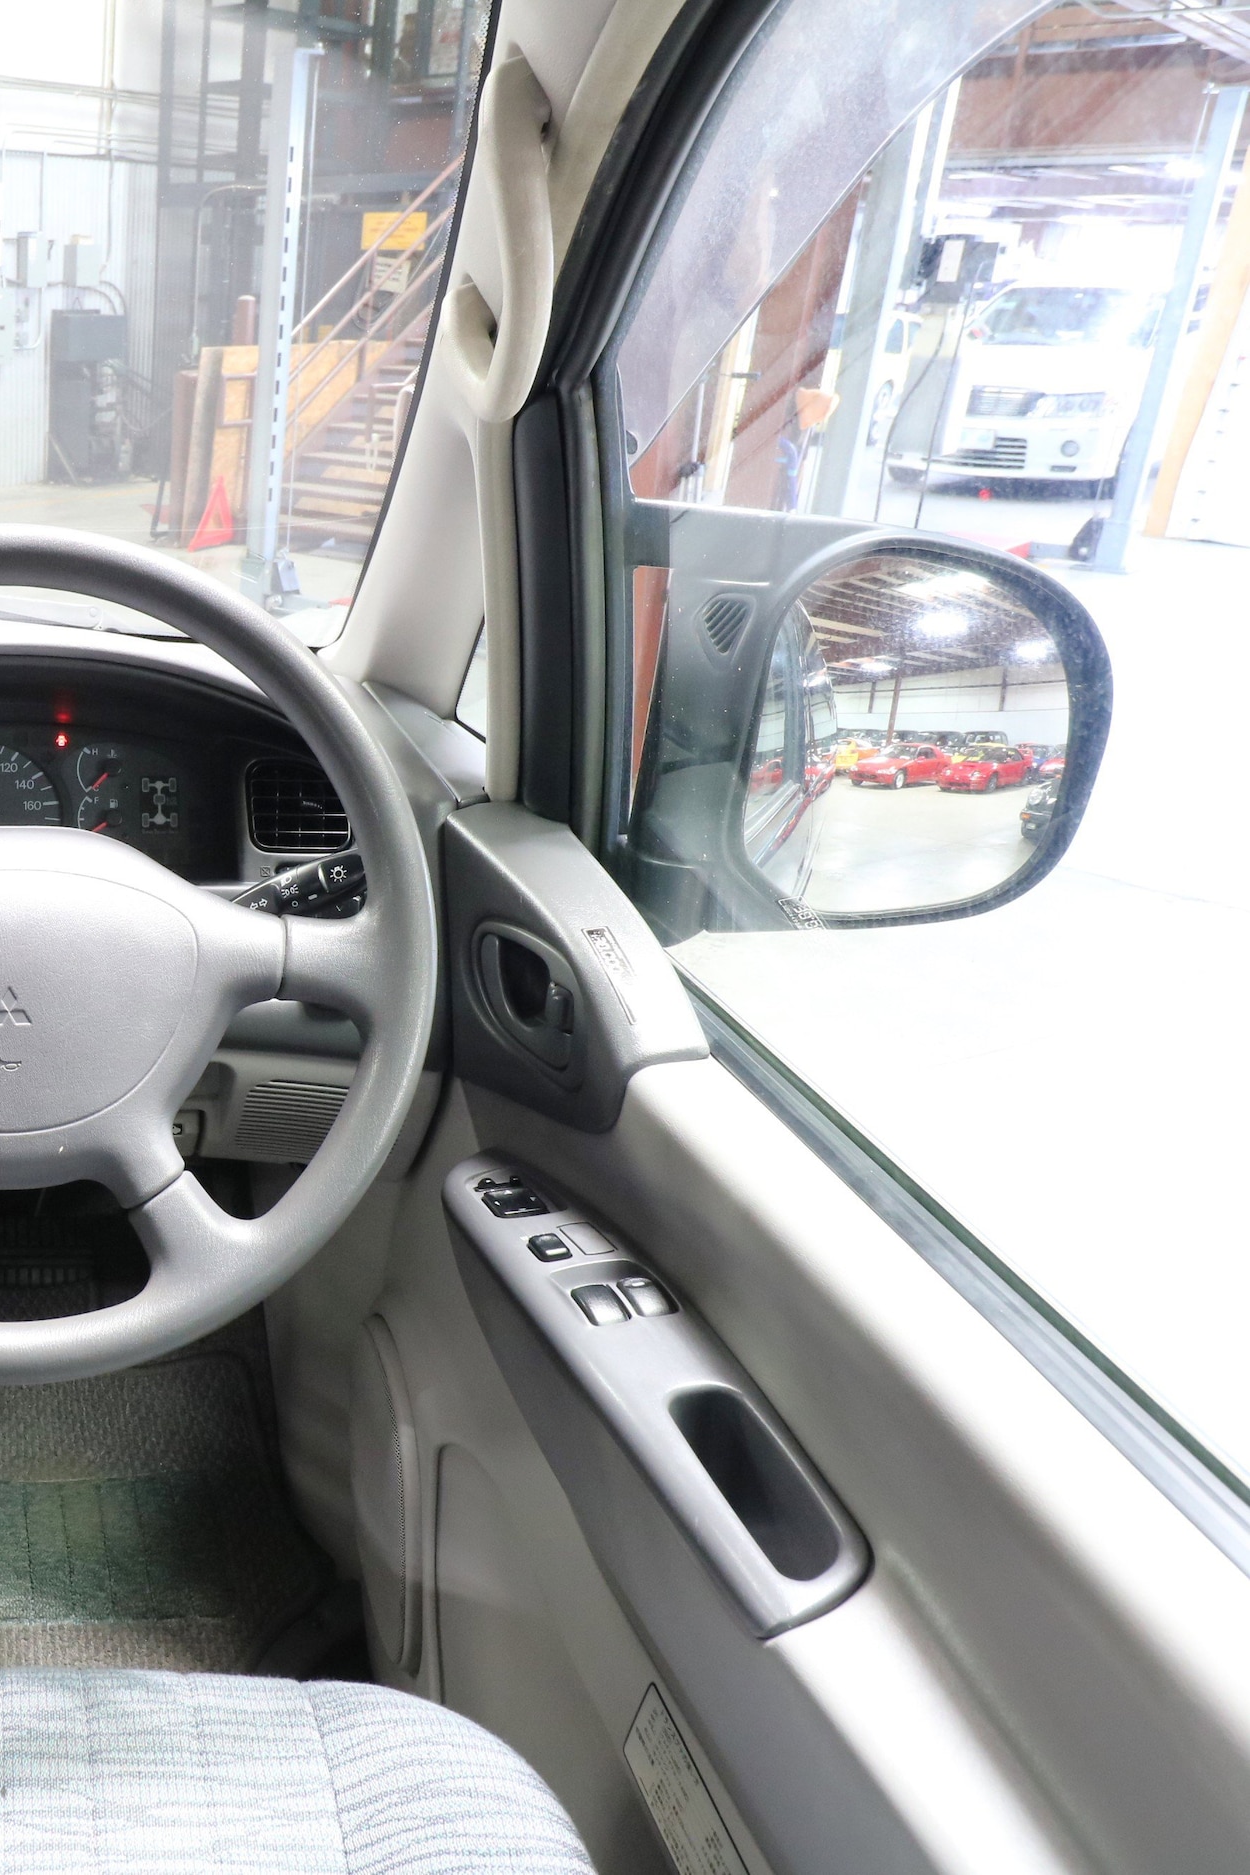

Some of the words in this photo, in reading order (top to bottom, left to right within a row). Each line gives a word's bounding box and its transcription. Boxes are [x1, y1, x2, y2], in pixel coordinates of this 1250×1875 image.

[0, 762, 19, 773] 120
[14, 779, 35, 790] 140
[22, 800, 42, 811] 160
[94, 796, 100, 804] F
